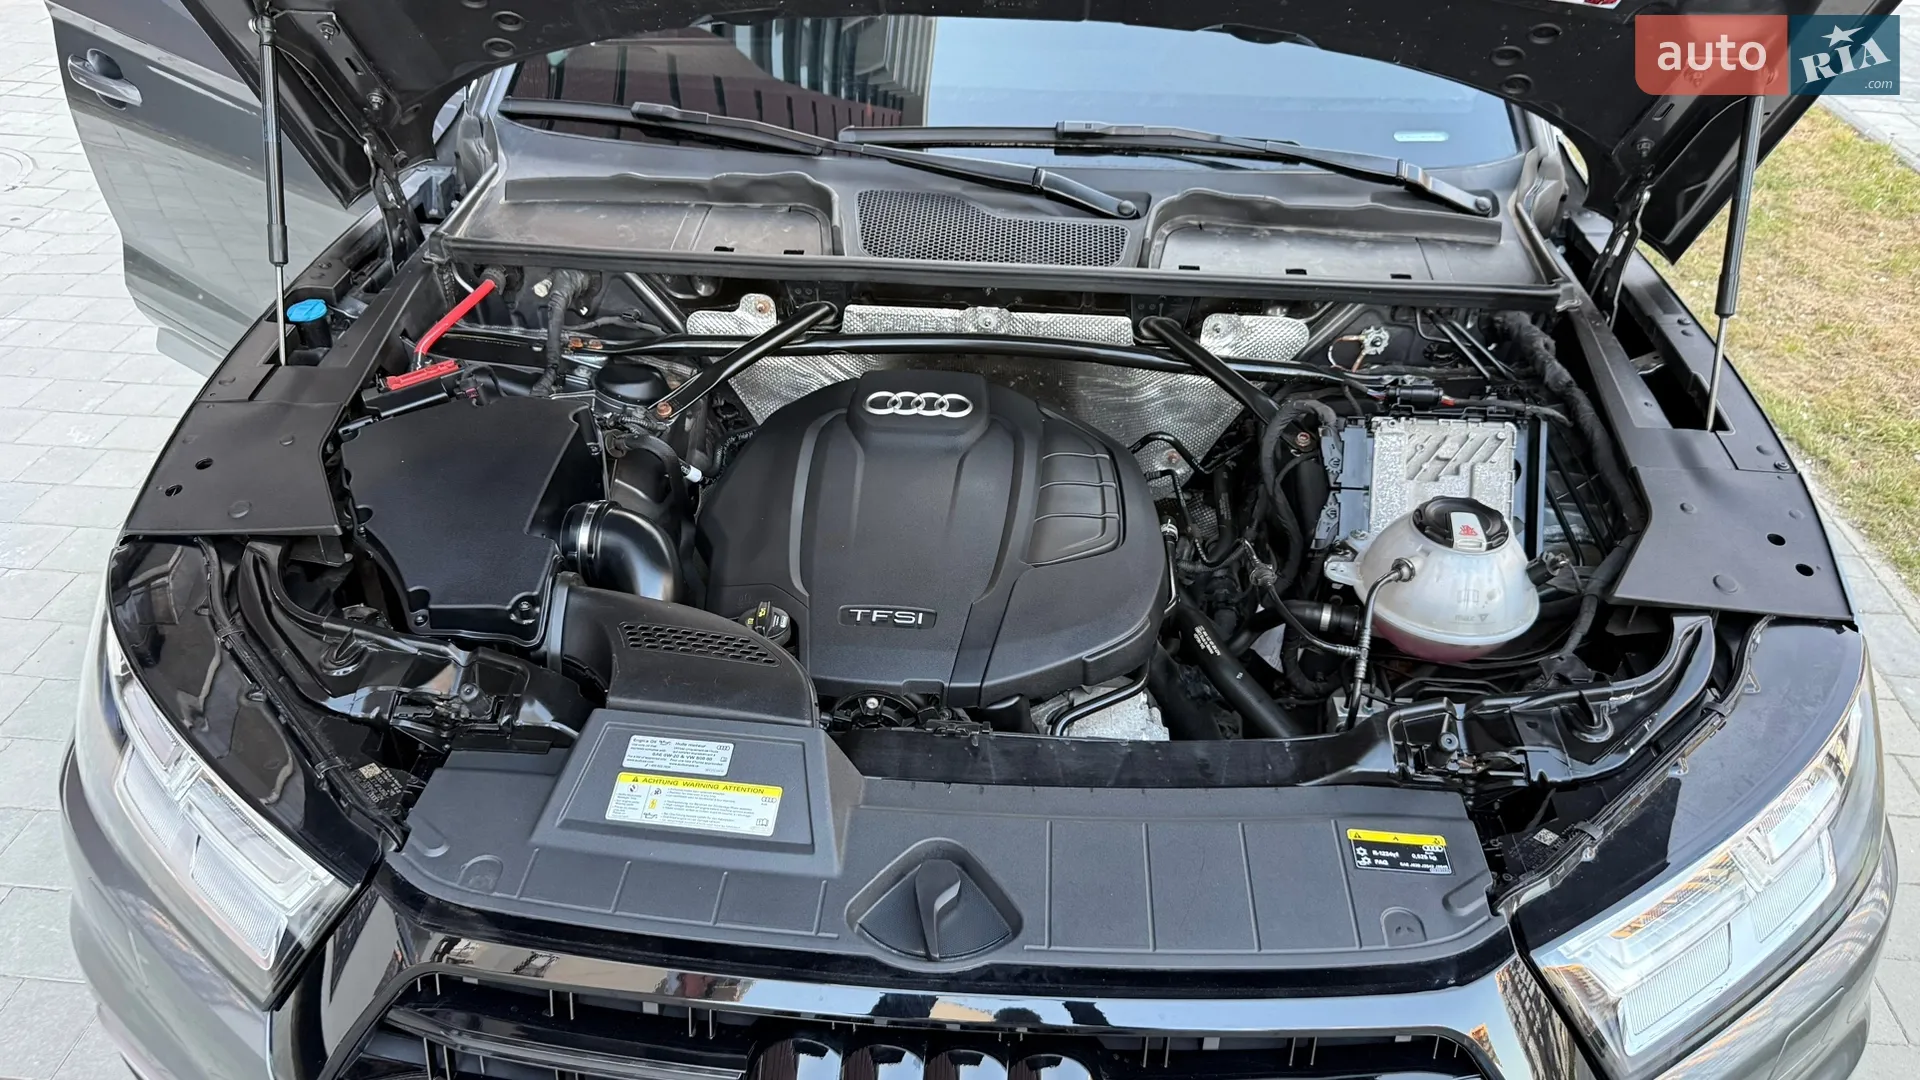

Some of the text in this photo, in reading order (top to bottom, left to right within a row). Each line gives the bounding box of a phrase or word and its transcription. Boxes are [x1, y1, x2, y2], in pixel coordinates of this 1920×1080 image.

[849, 609, 923, 625] TFSI
[642, 776, 680, 787] ACHTUNG
[682, 781, 720, 791] WARNING
[723, 784, 765, 795] ATTENTION
